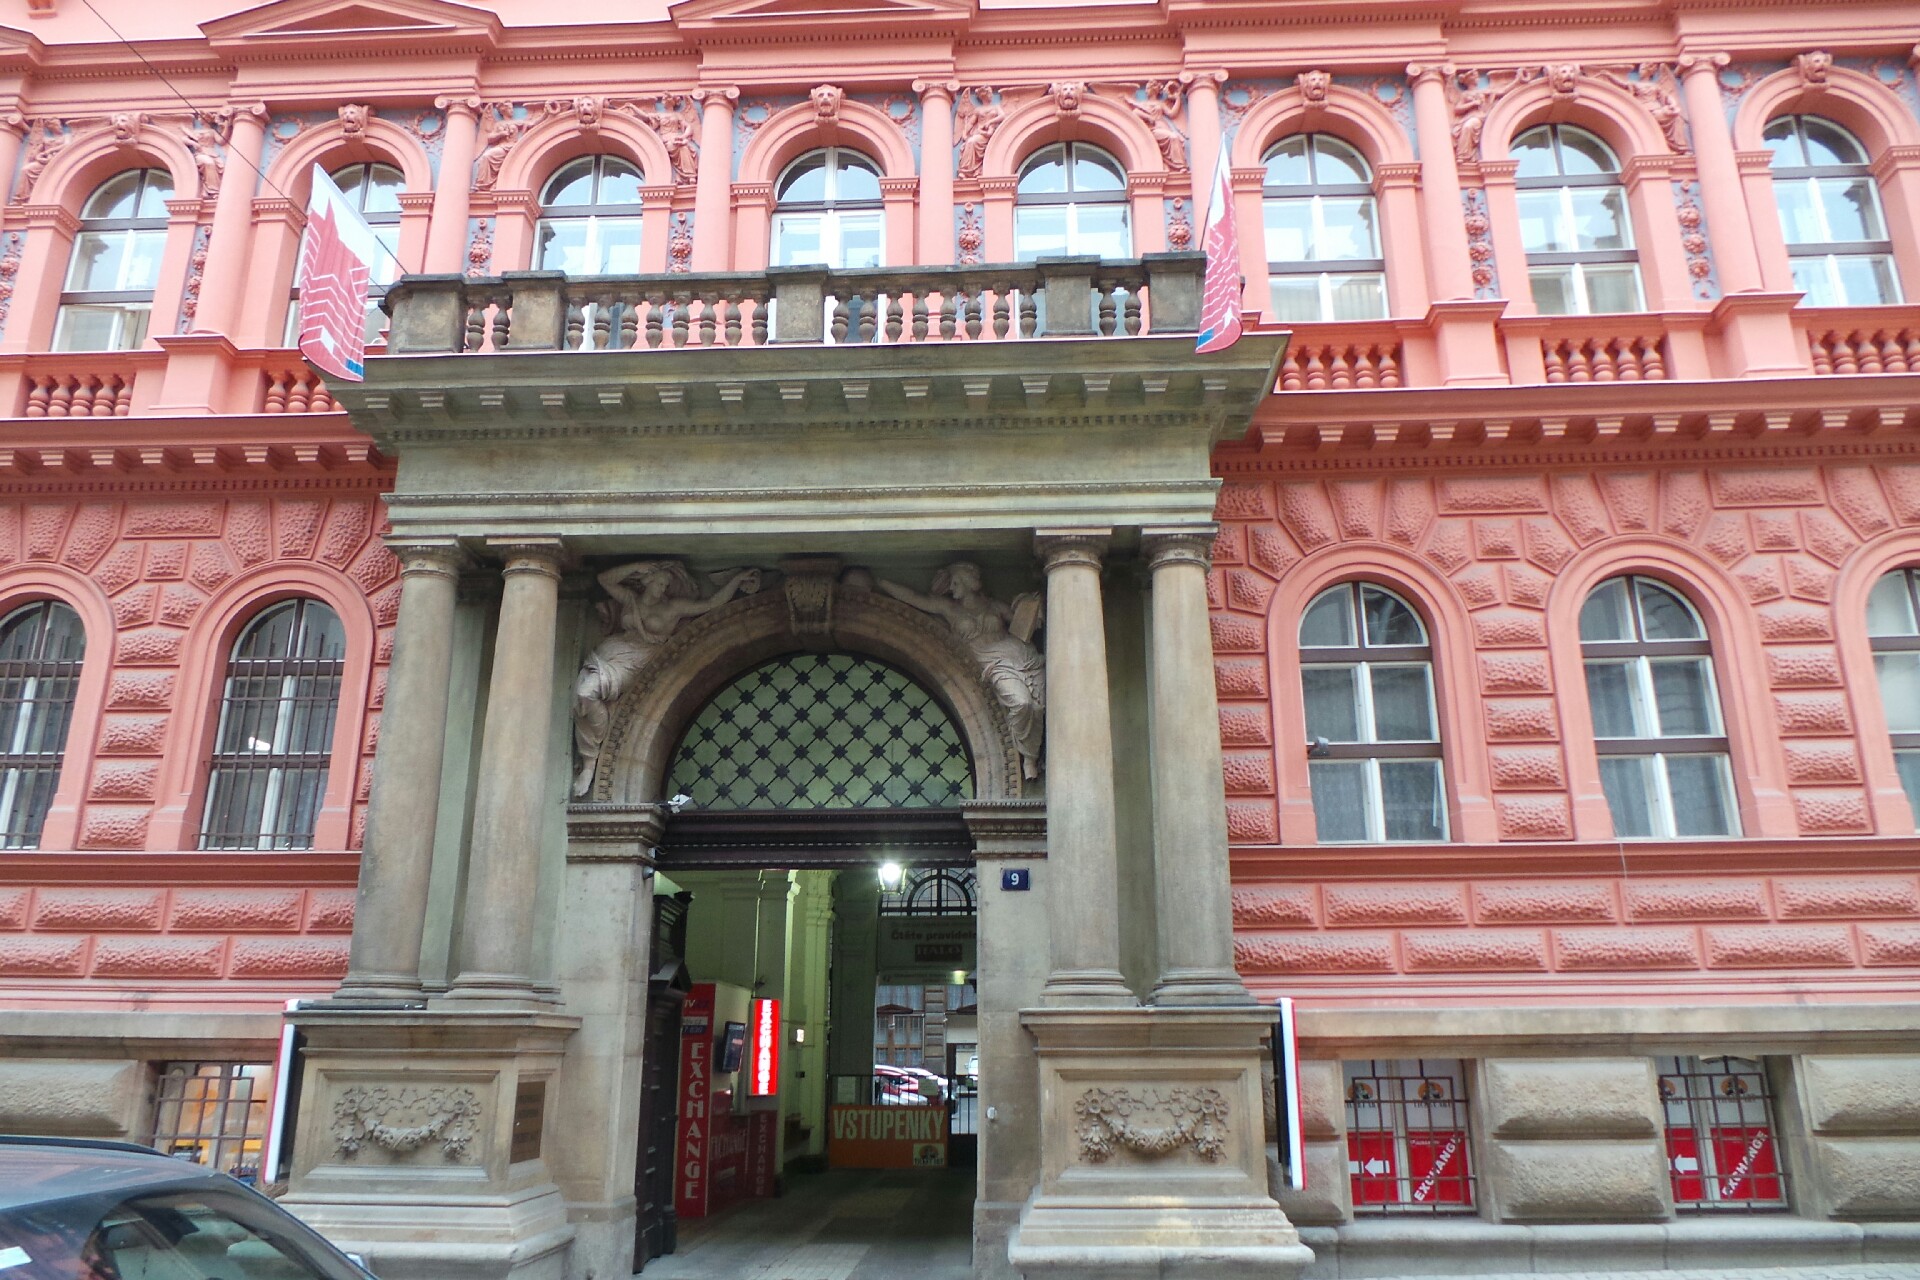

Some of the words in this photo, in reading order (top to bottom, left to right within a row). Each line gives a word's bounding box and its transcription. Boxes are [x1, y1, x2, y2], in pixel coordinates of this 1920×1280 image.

[1011, 873, 1019, 885] 9
[758, 1000, 772, 1095] EXCHANGE
[685, 1042, 704, 1199] EXCHANGE
[833, 1109, 945, 1140] VSTUPENKY
[1414, 1134, 1461, 1201] EXCANG
